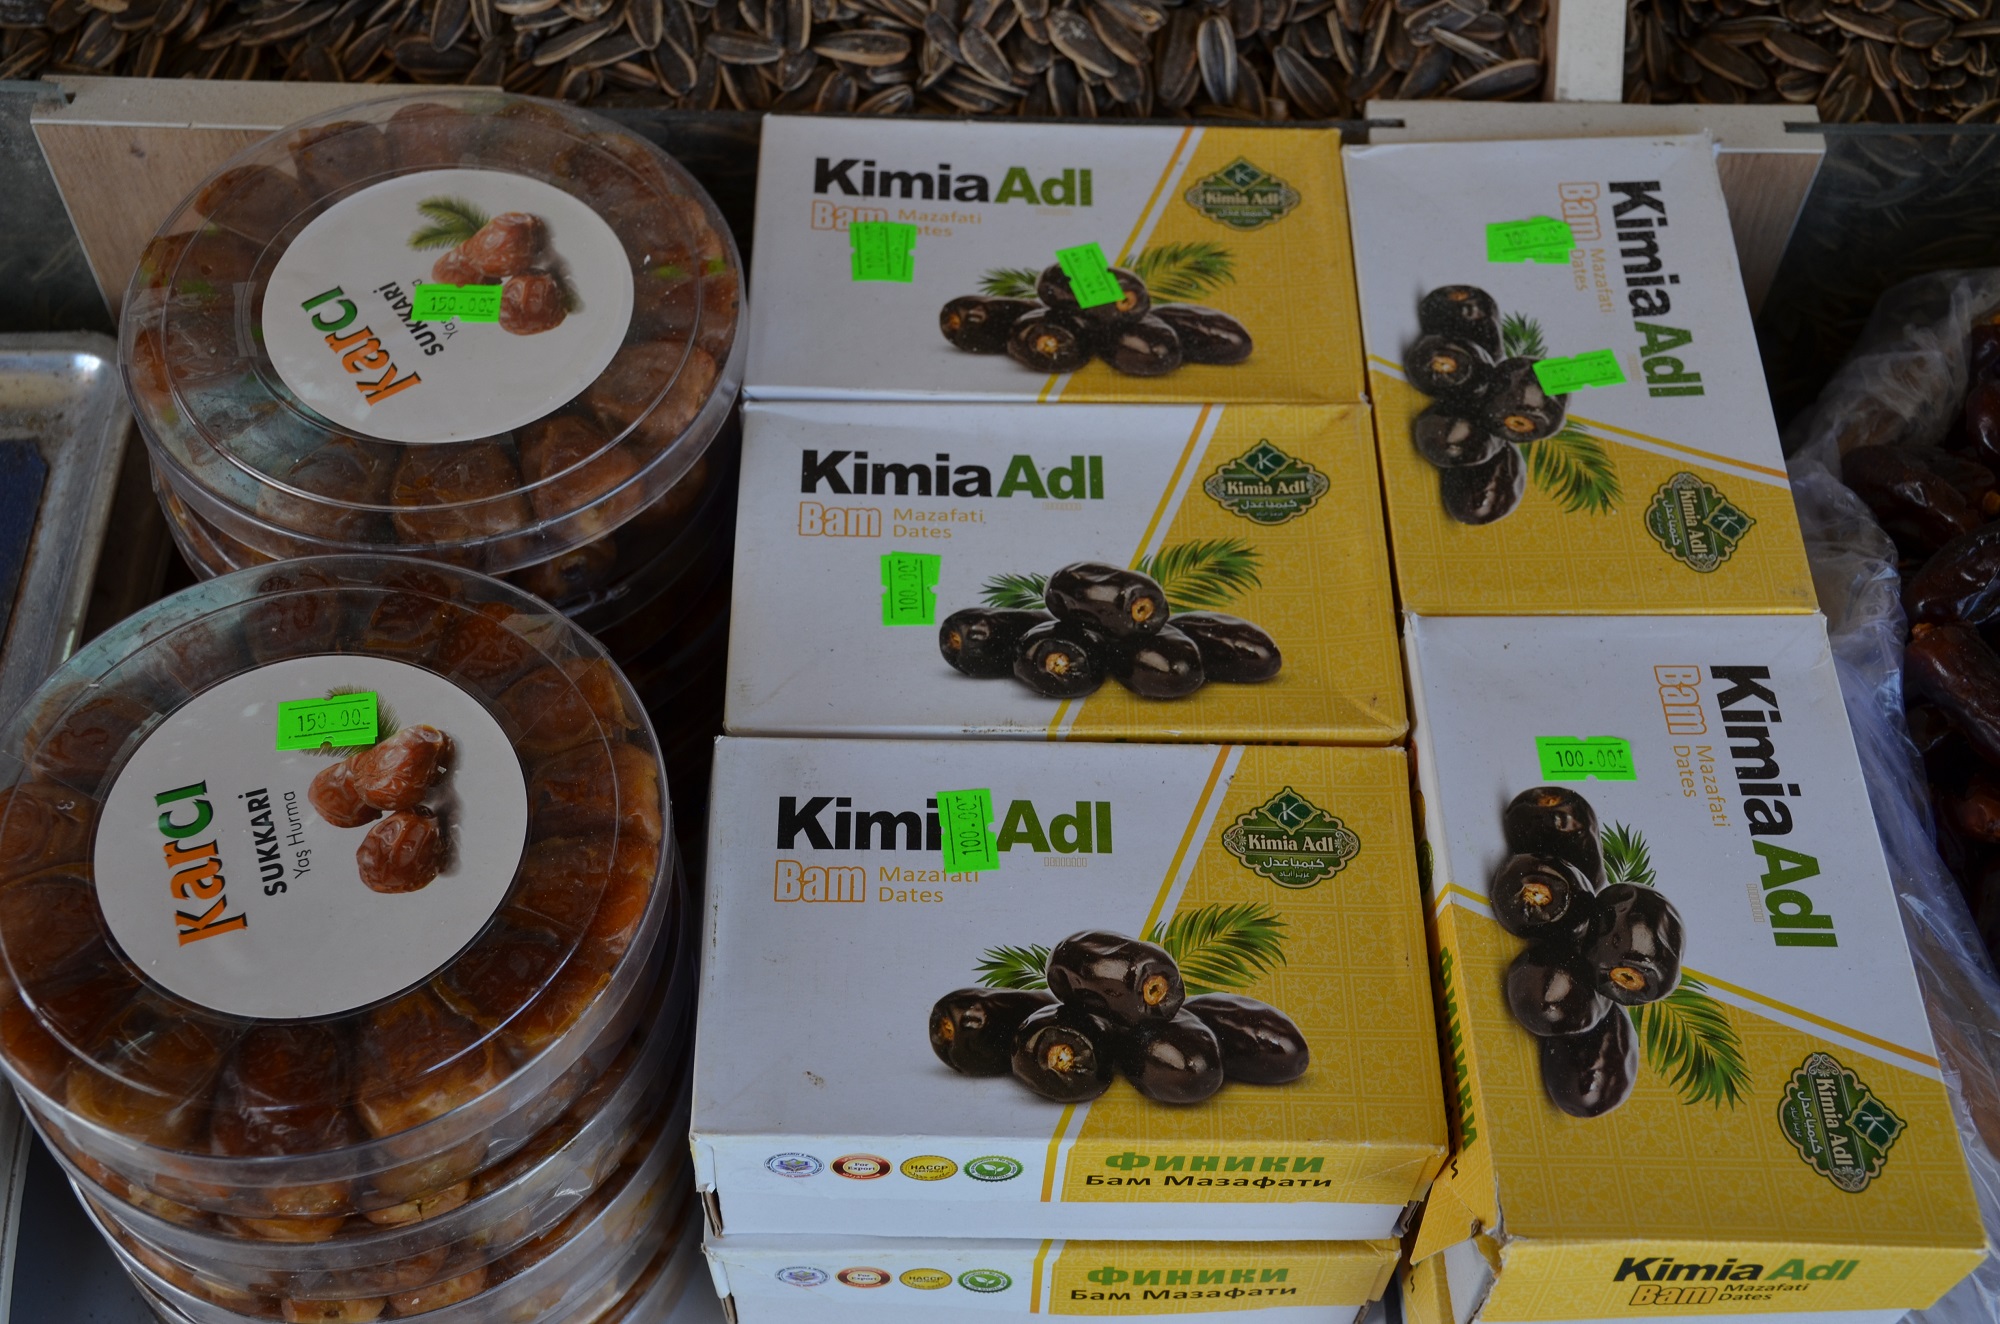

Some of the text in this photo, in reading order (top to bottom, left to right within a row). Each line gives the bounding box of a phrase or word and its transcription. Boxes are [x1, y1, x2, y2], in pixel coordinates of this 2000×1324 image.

[898, 208, 982, 225] Mazafati
[1558, 182, 1616, 314] Bam Mazafati
[1570, 249, 1588, 292] Dates
[1227, 480, 1306, 495] Kimia Adl
[799, 501, 984, 537] Bam Mazafati
[1679, 490, 1708, 553] Kimia Adl
[893, 524, 952, 539] Dates
[1654, 665, 1731, 827] Bam Mazafati
[1673, 745, 1697, 799] Dates
[284, 790, 311, 880] Yaş Hurma
[1248, 834, 1334, 852] Kimia Adl
[774, 859, 866, 903] Bam
[878, 886, 944, 903] Dates
[1815, 1079, 1855, 1165] Kimia Adl
[1105, 1151, 1325, 1173] ФИНИКИ
[1086, 1174, 1332, 1189] Бам Мазафати
[1087, 1266, 1289, 1286] ФИНИКИ
[1071, 1286, 1297, 1301] Бам Мазафати
[1629, 1283, 1810, 1306] Bam Mazafati
[1718, 1292, 1773, 1301] Dates
